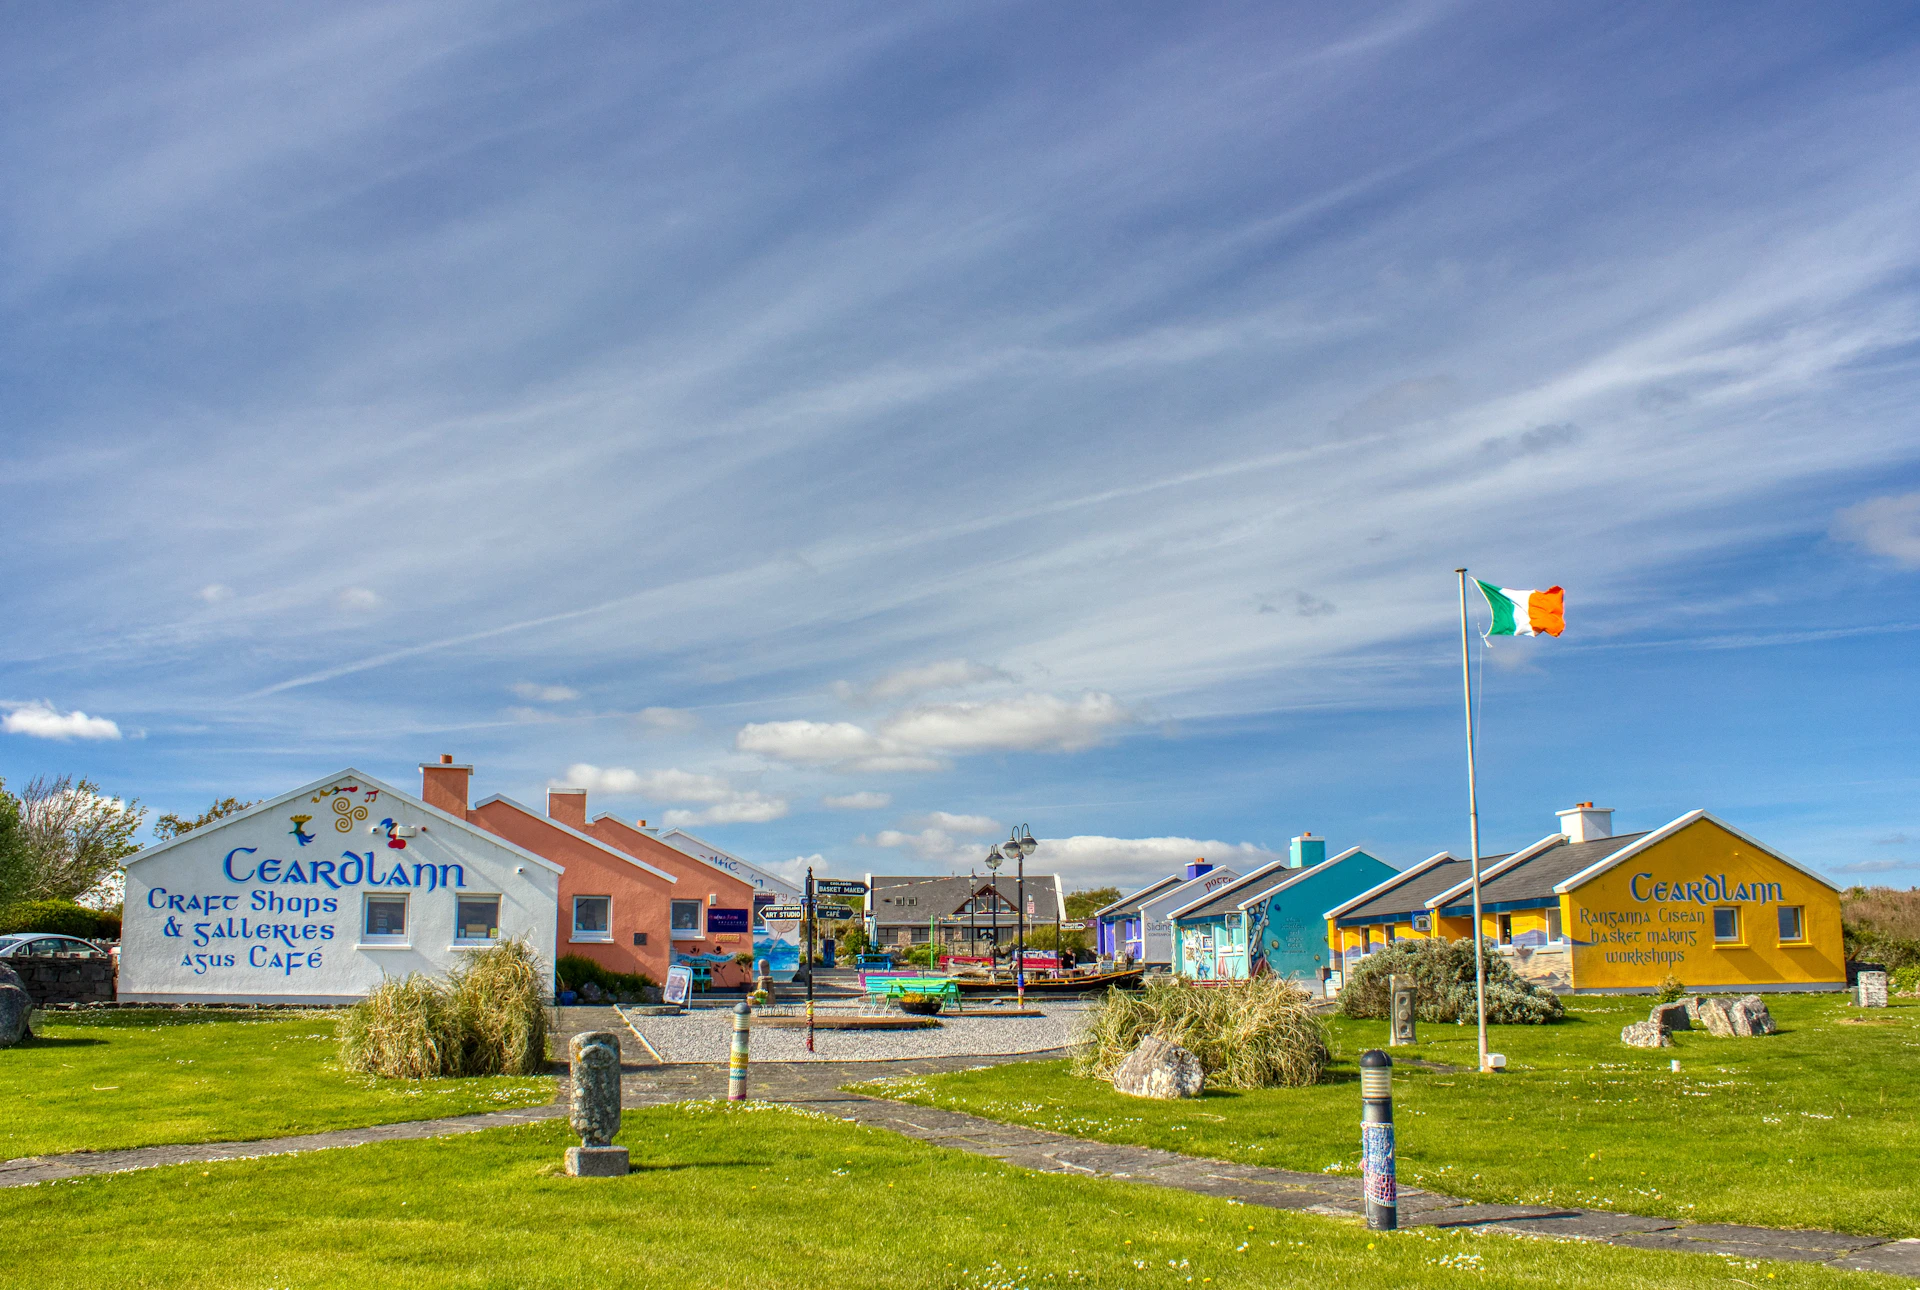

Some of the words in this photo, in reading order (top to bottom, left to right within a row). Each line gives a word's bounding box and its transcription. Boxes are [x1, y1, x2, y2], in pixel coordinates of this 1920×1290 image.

[223, 846, 466, 893] Ceardlann
[818, 885, 842, 893] BASKET
[1629, 872, 1785, 906] Ceardlann
[148, 887, 239, 915] Craft
[250, 889, 339, 918] Shops
[163, 915, 182, 938] &
[1580, 907, 1651, 928] Ranganna
[1590, 928, 1642, 945] basket
[1647, 928, 1697, 947] making
[181, 953, 236, 975] agus
[249, 946, 323, 976] Café
[1606, 948, 1685, 970] workshops
